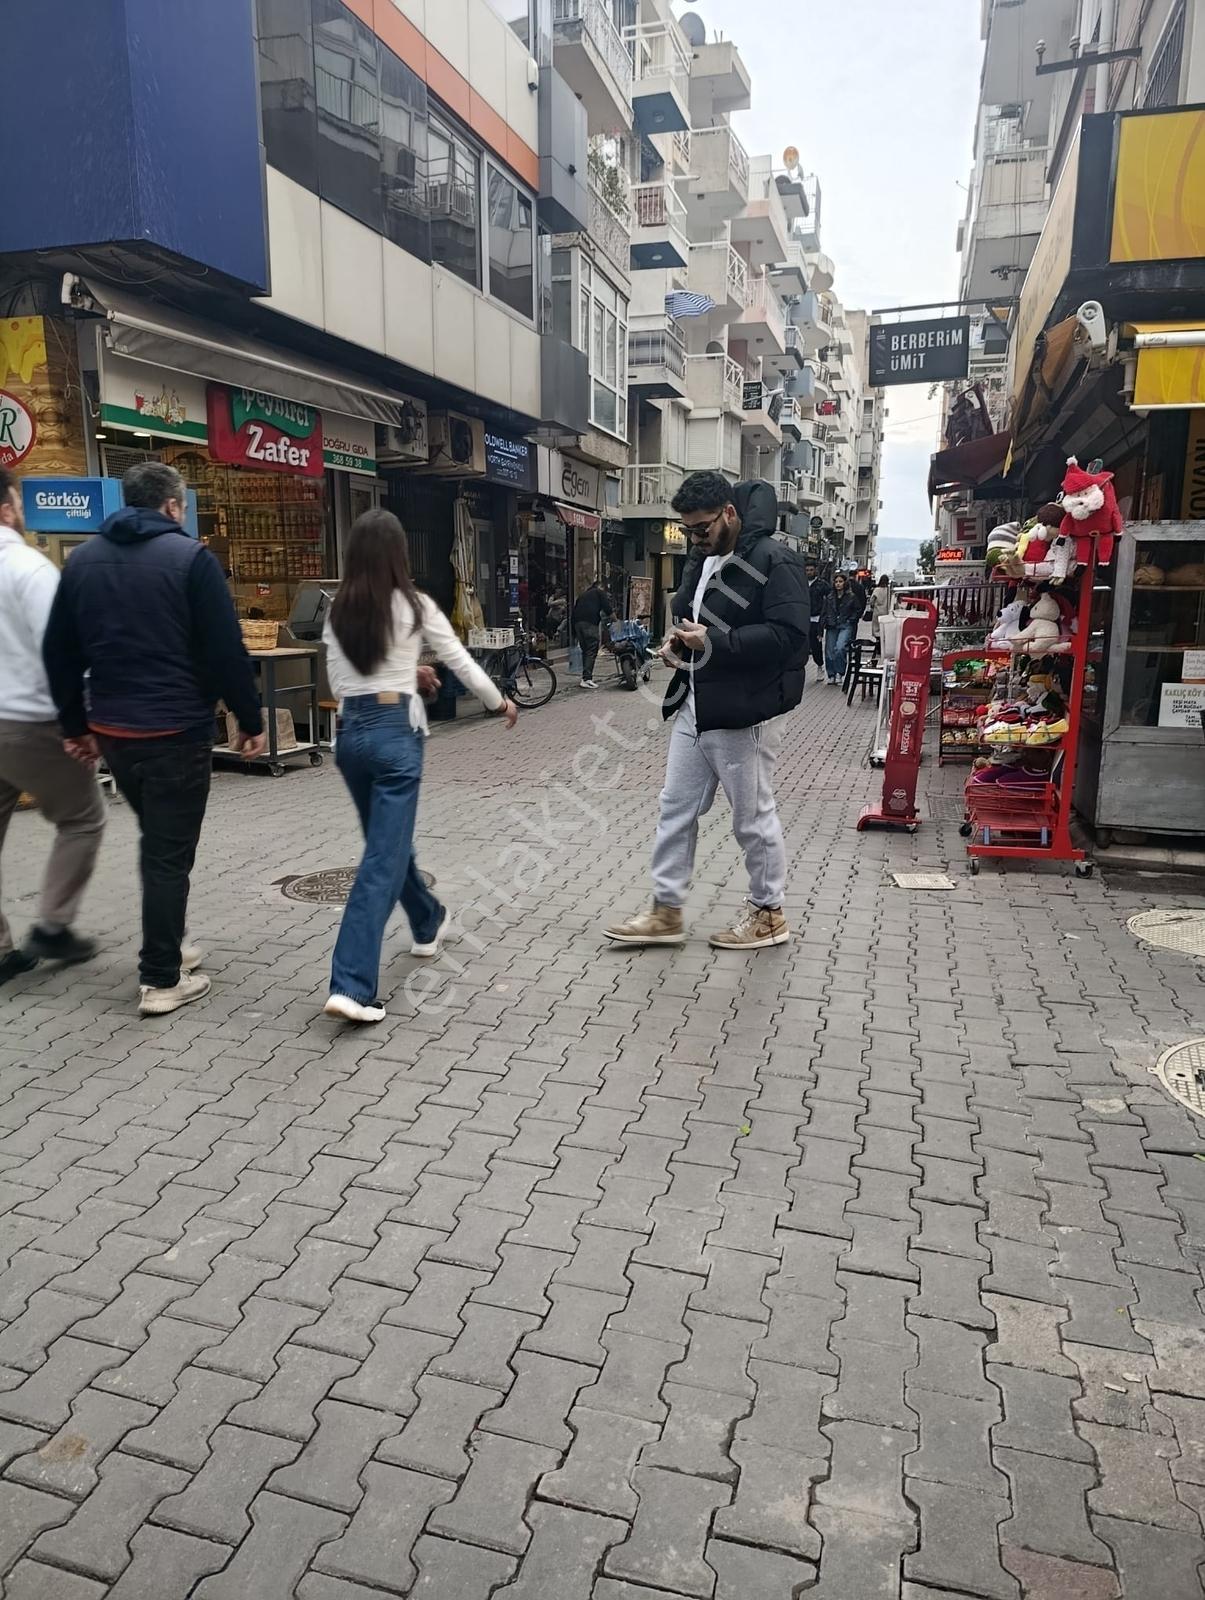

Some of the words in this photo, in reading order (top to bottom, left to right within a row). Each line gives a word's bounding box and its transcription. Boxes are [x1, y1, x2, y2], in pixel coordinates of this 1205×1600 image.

[246, 424, 311, 468] Zafer
[323, 437, 350, 453] DOĞRU
[352, 444, 369, 456] GIDA
[35, 491, 90, 508] Görköy
[66, 508, 92, 519] çiftliği
[956, 518, 977, 541] E
